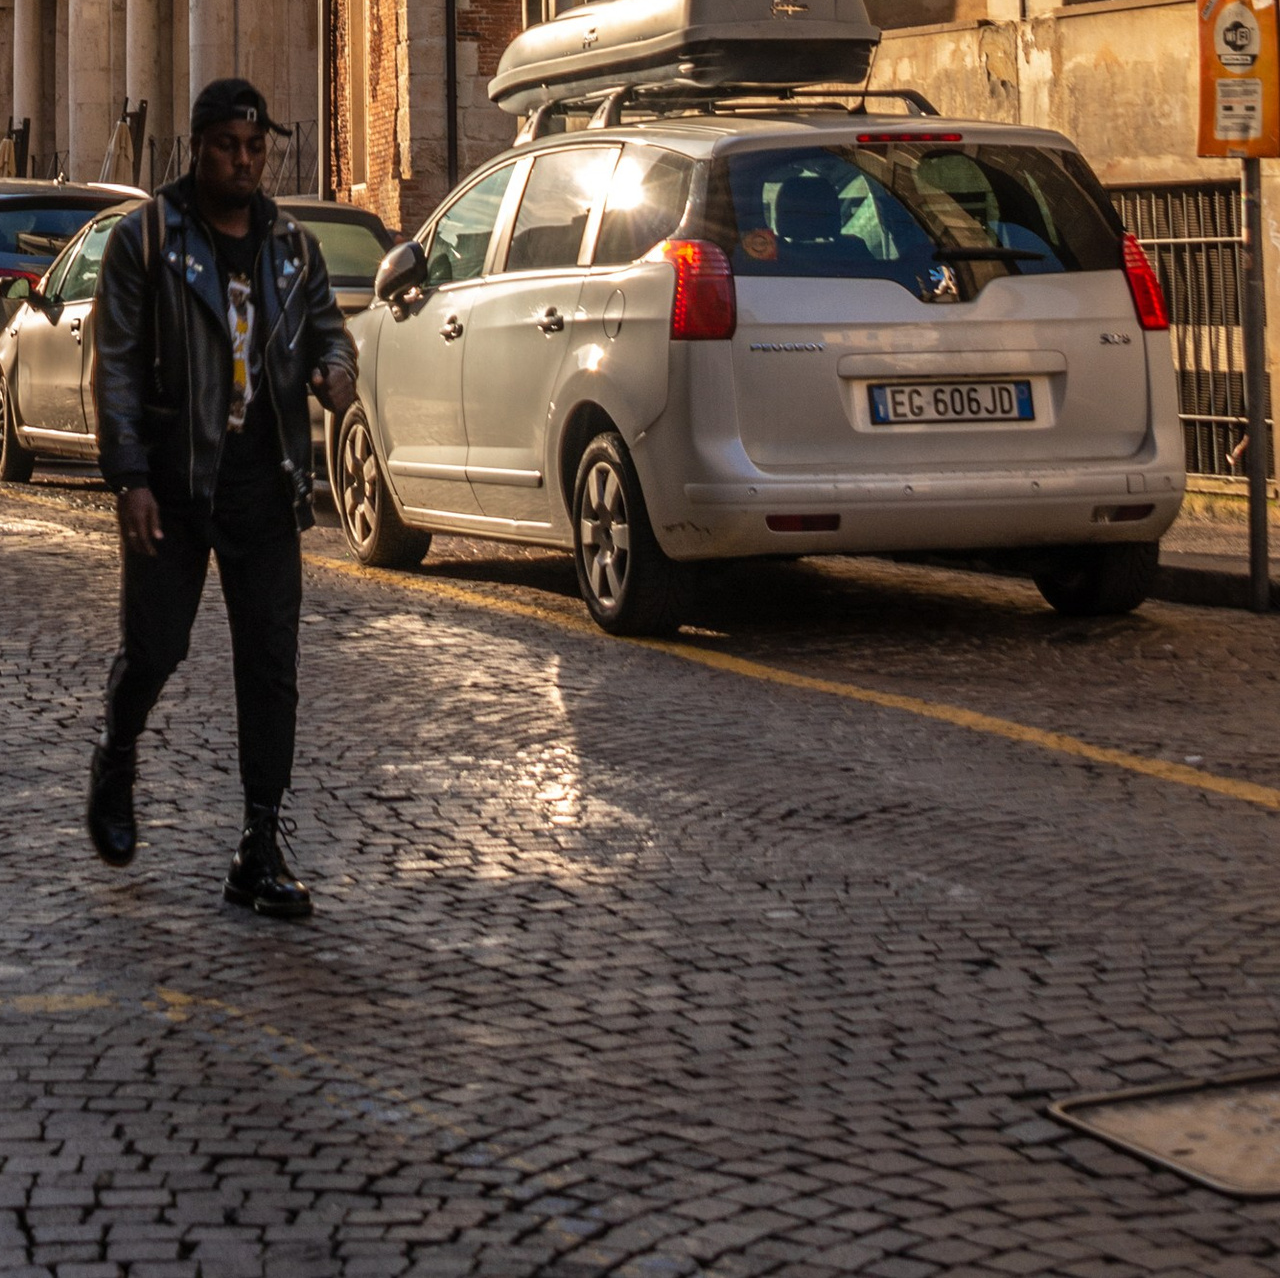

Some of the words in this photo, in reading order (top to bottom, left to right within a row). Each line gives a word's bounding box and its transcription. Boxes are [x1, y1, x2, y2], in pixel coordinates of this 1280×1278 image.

[750, 342, 826, 352] PEUGEOT
[890, 388, 924, 418] EG
[933, 386, 1014, 416] 606JD
